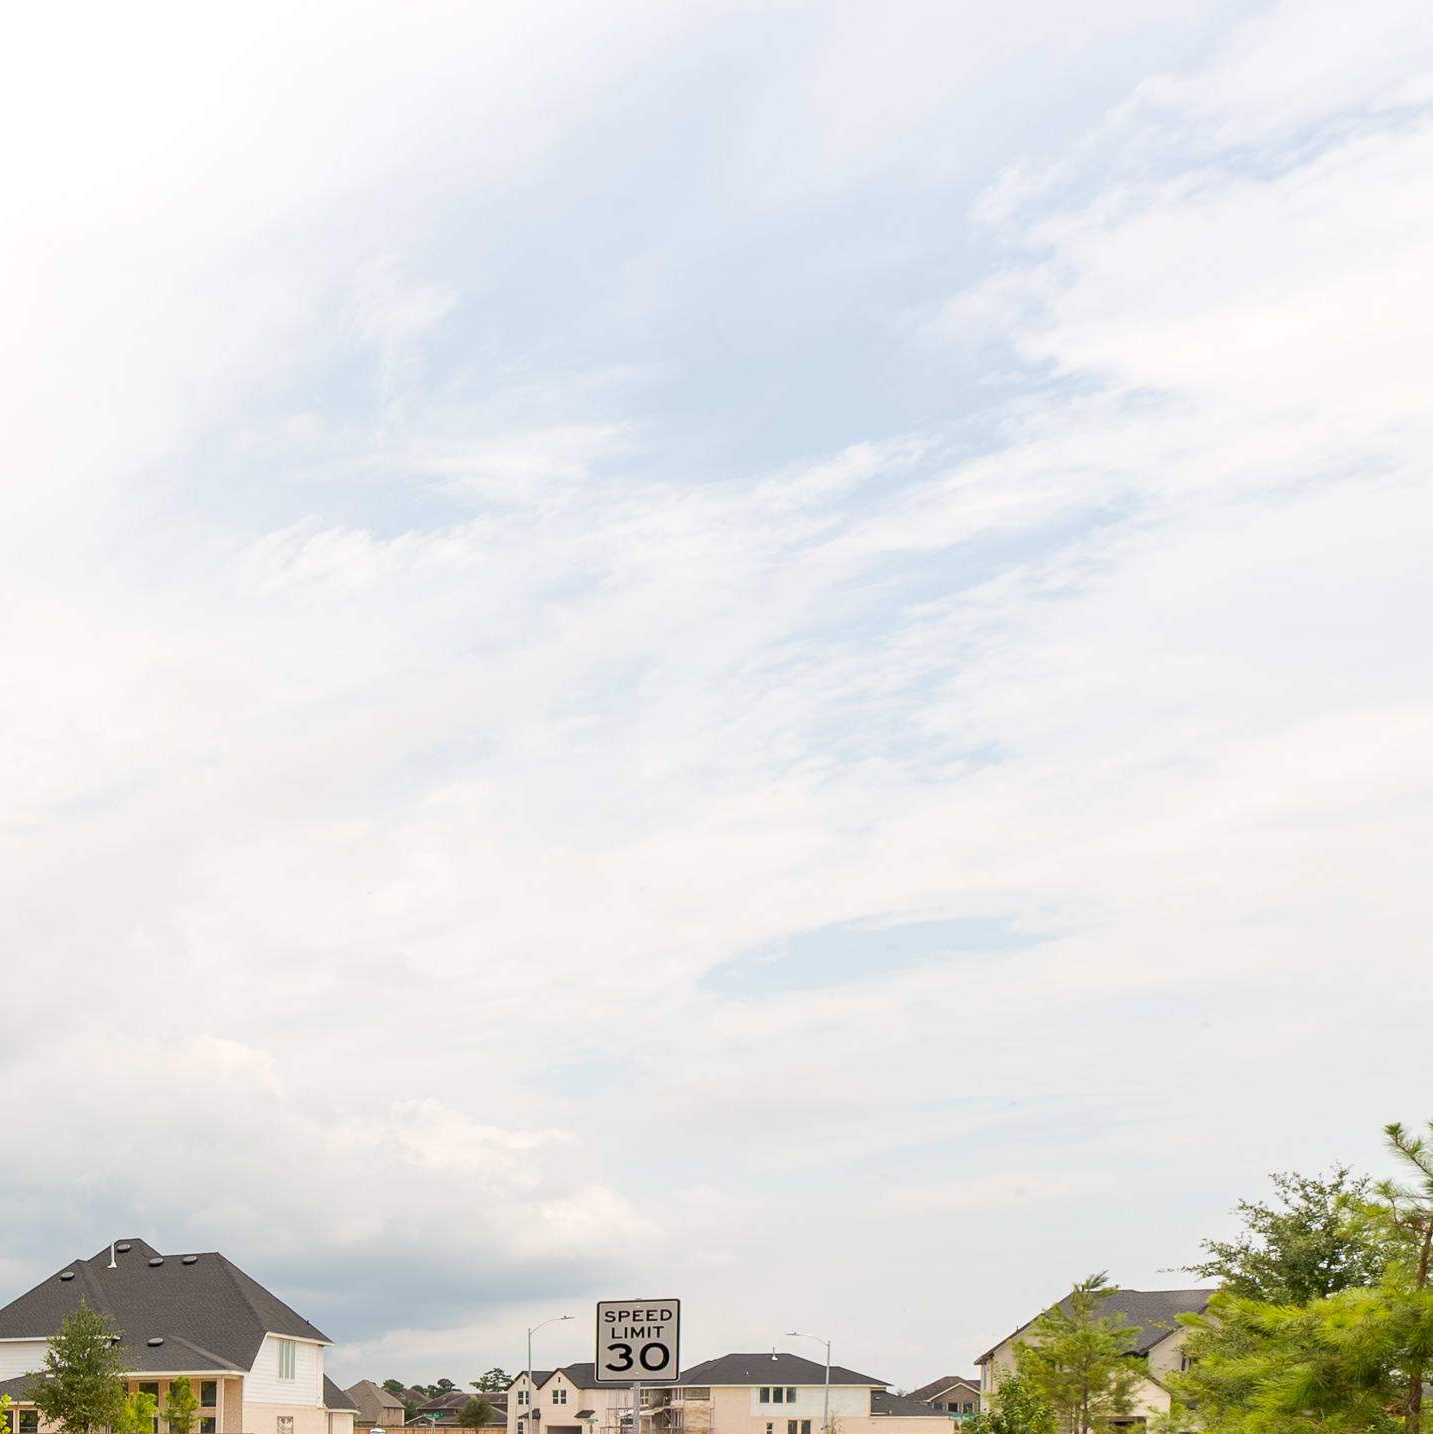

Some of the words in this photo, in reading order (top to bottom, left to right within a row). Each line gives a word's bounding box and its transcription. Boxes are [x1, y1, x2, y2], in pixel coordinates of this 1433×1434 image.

[604, 1309, 672, 1323] SPEED
[611, 1326, 664, 1339] LIMIT
[604, 1342, 670, 1372] 30
